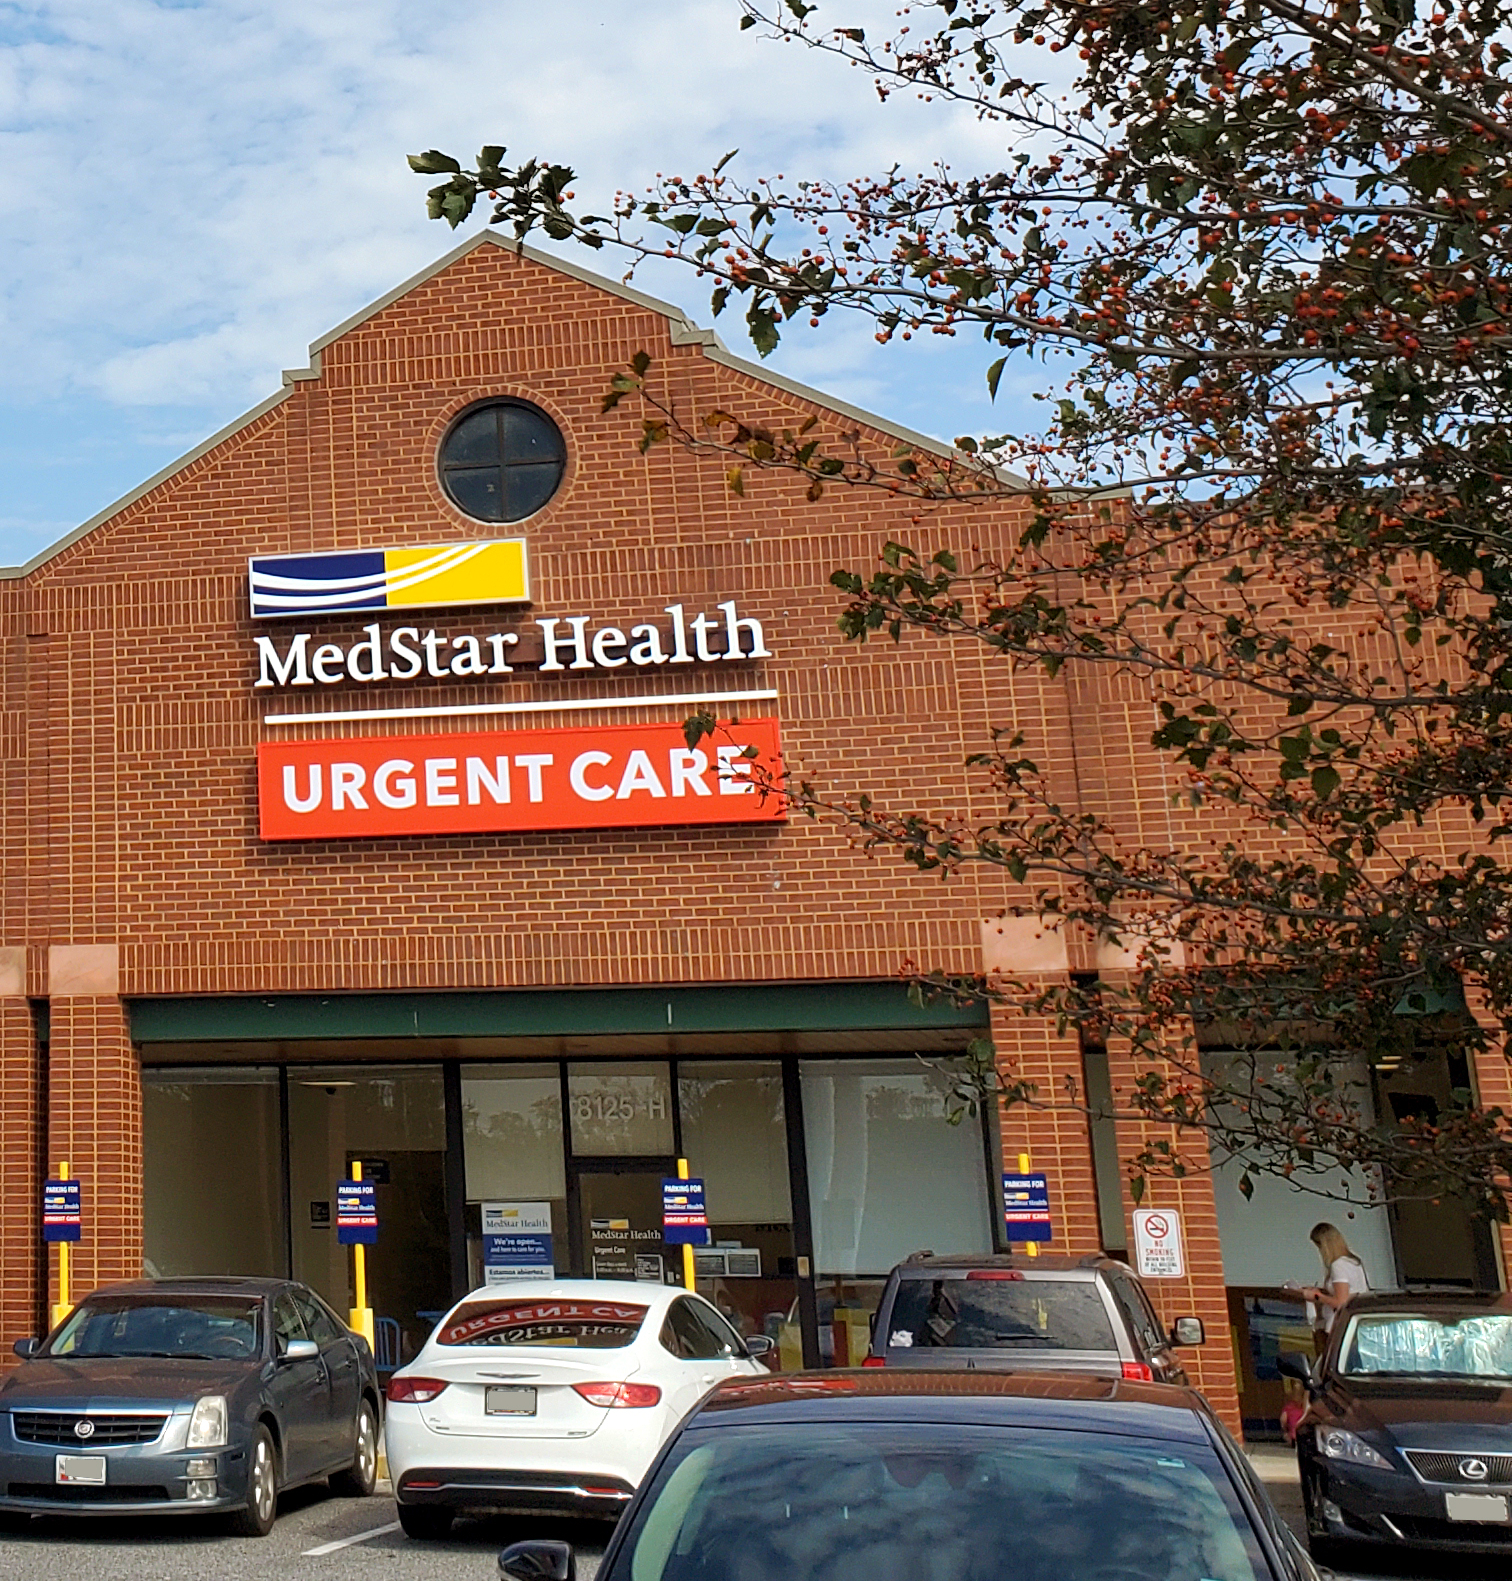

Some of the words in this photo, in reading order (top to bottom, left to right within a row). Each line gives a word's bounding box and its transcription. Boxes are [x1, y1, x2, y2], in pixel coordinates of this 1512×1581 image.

[253, 622, 518, 688] MedStar
[535, 600, 772, 672] Health
[282, 753, 554, 813] URGENT
[569, 744, 756, 803] CARE
[664, 1185, 689, 1193] PARKING
[690, 1185, 702, 1193] FOR
[1004, 1180, 1031, 1188] PARKING
[1032, 1180, 1044, 1188] FOR
[486, 1219, 519, 1228] MedStar
[521, 1218, 548, 1228] Health
[592, 1230, 628, 1239] MedStar
[630, 1229, 661, 1239] Health
[1145, 1248, 1174, 1256] SMOKING
